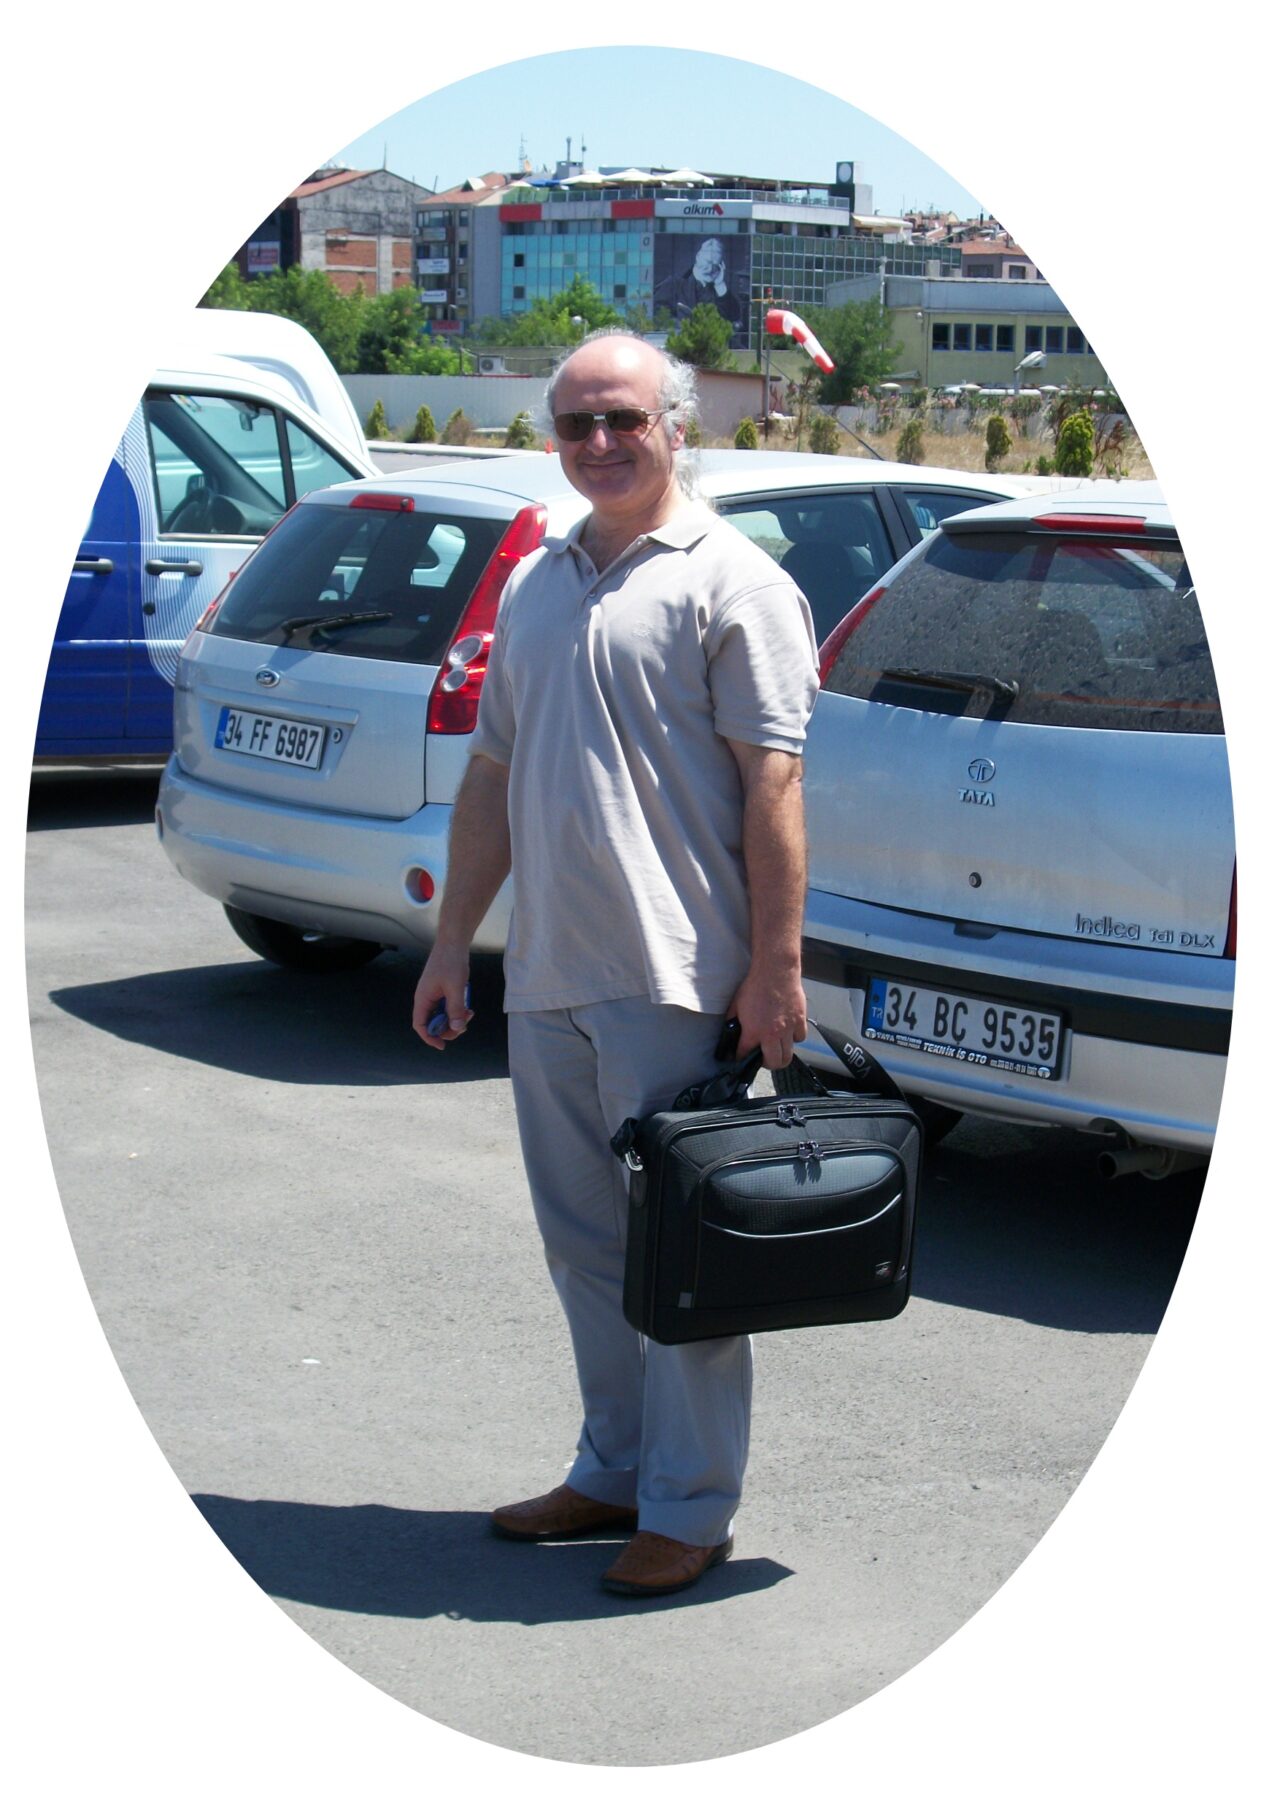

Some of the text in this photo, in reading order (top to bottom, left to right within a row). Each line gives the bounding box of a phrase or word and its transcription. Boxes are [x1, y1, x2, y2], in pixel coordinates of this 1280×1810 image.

[225, 714, 319, 762] 34 FF 6987
[959, 788, 995, 807] TATA
[1076, 912, 1141, 941] Indica
[1180, 931, 1216, 949] DLX
[872, 1006, 884, 1019] TR
[886, 987, 918, 1031] 34
[982, 1007, 1055, 1061] 9535
[876, 1031, 895, 1043] TATA
[922, 1042, 957, 1058] TEKNİK
[967, 1052, 988, 1064] OTO
